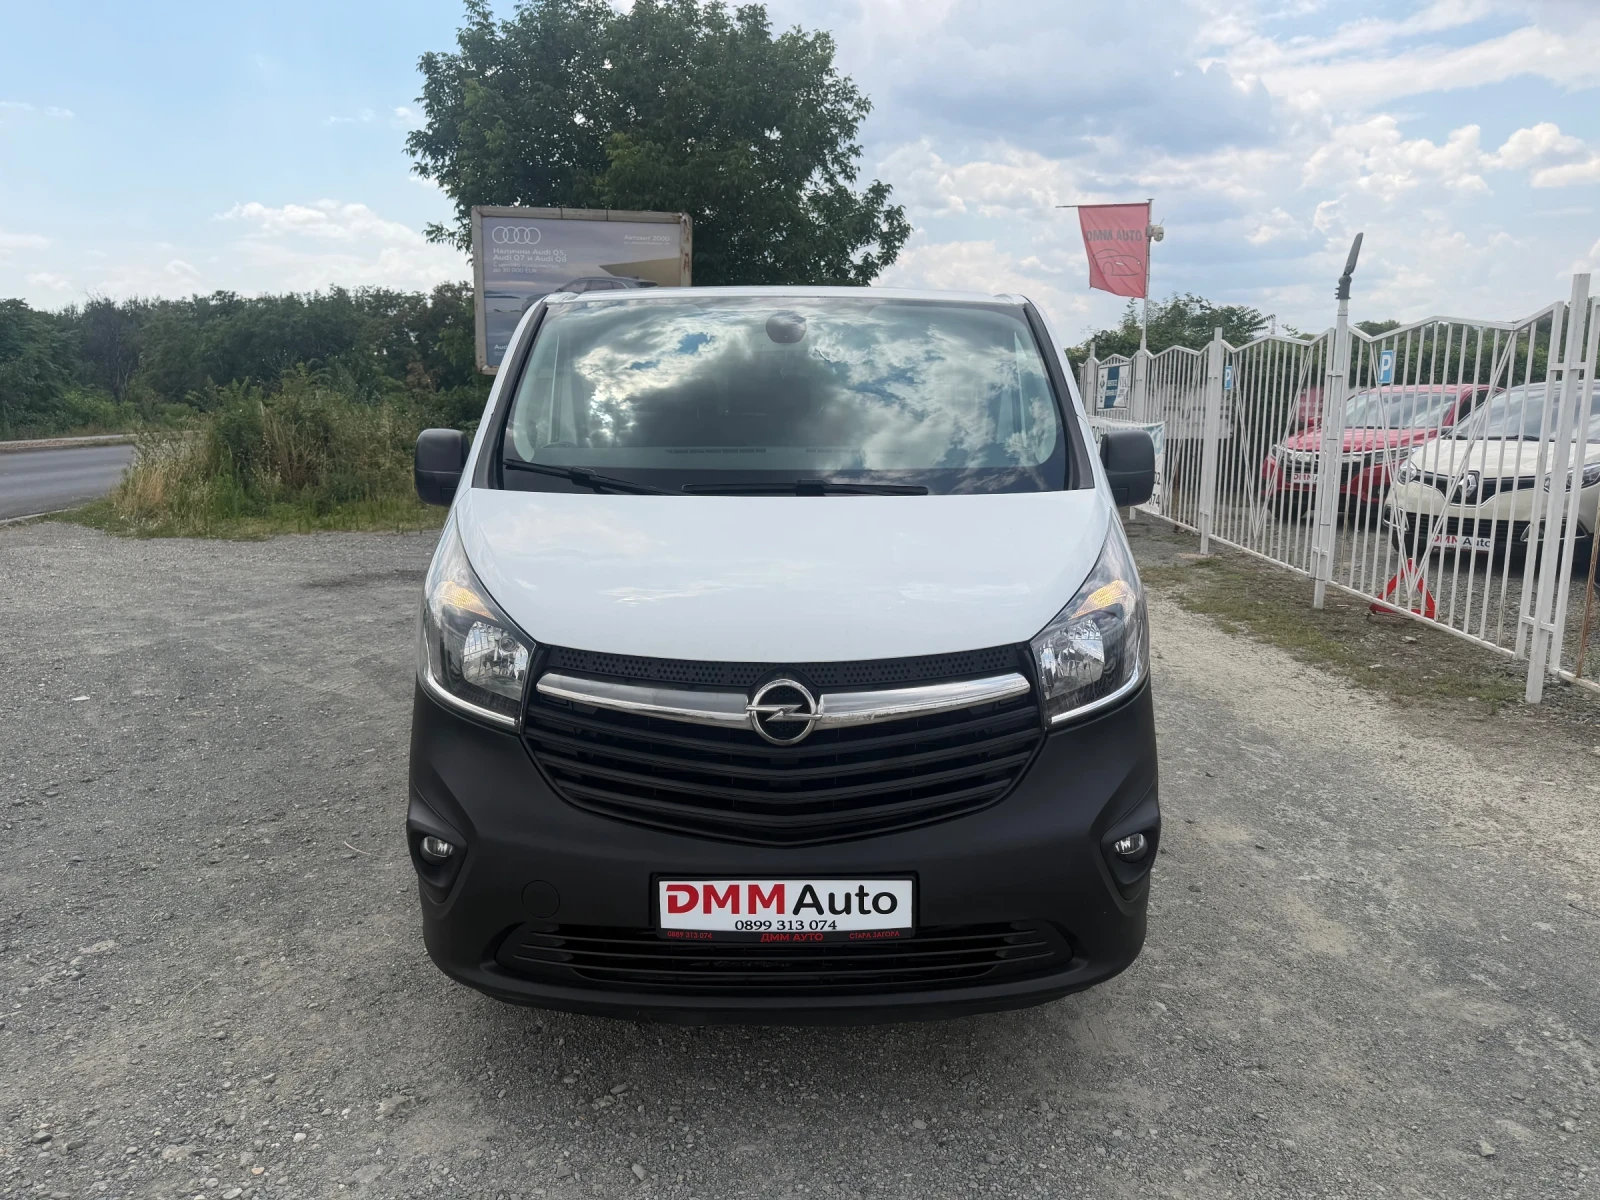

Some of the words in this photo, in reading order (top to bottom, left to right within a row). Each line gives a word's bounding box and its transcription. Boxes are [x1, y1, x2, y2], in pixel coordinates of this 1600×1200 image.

[1116, 229, 1143, 242] AUTO
[493, 247, 530, 255] Налични
[532, 248, 551, 256] Audi
[1380, 354, 1393, 380] P
[1225, 368, 1232, 388] P
[666, 884, 785, 914] DMM
[792, 884, 898, 915] Auto
[735, 920, 772, 931] 0899
[776, 920, 805, 931] 313
[809, 920, 838, 931] 074
[685, 931, 698, 939] 313
[760, 932, 790, 942] ДММ
[793, 932, 823, 941] АУТО
[873, 930, 900, 938] ЗАГОРА
